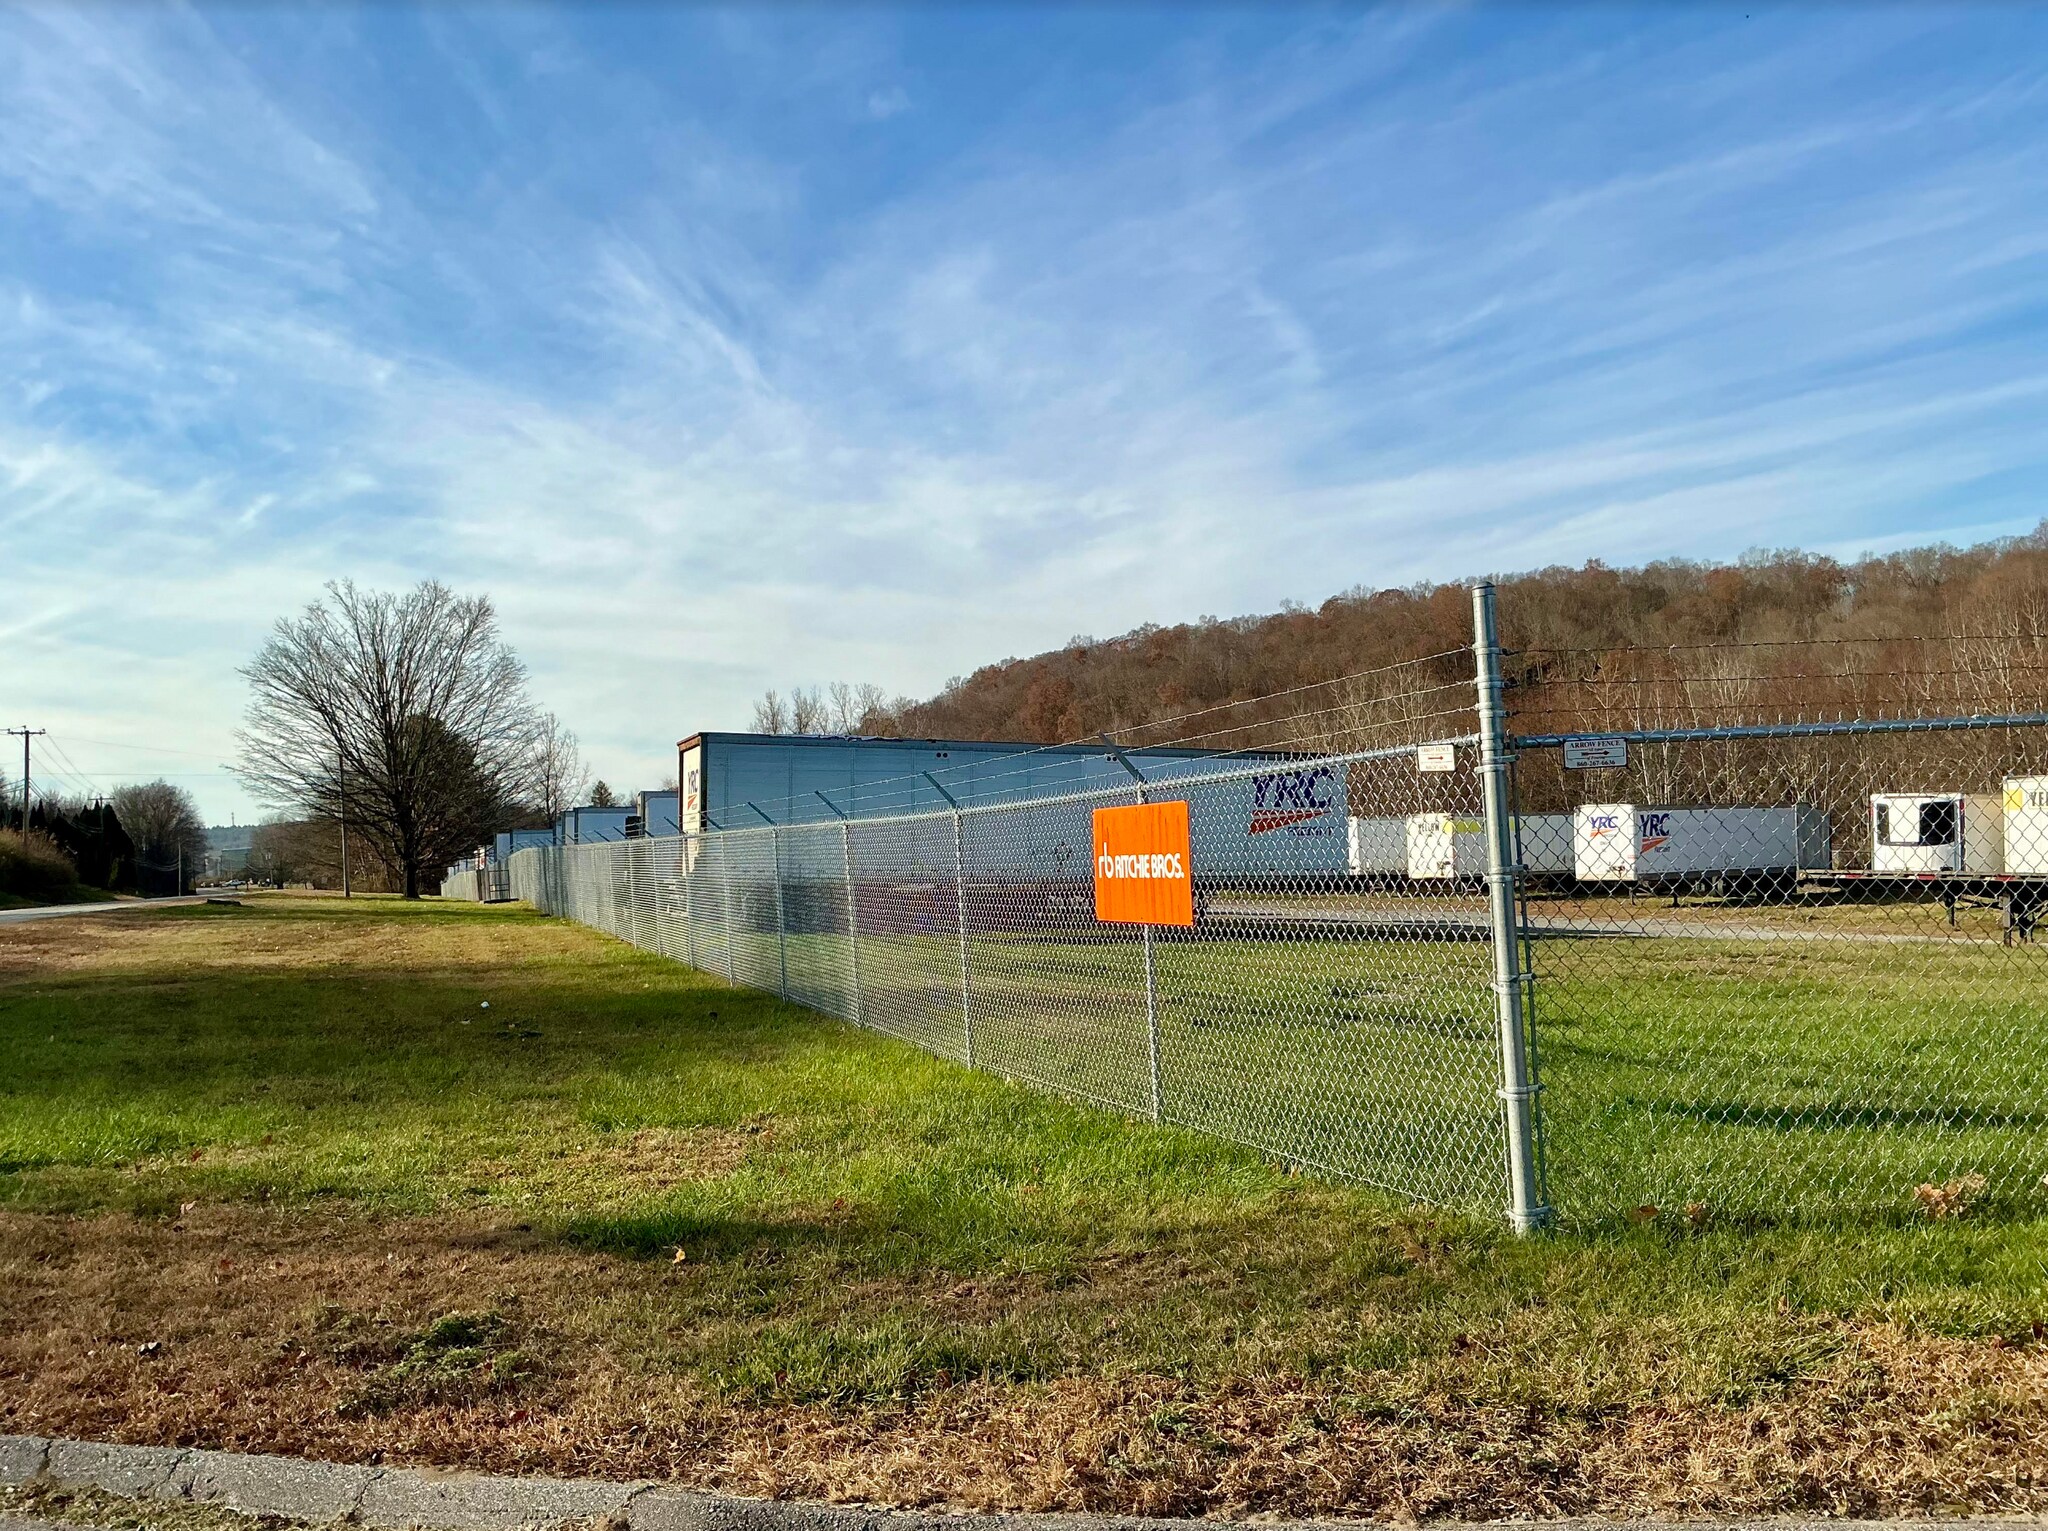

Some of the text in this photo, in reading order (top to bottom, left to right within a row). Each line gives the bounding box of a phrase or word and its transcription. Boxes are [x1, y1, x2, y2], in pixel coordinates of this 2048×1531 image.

[1252, 767, 1334, 808] YRC
[1590, 815, 1619, 829] YRC
[1641, 813, 1670, 838] YRC
[1115, 853, 1151, 879] RITCHIE
[1151, 852, 1185, 879] BROS.
